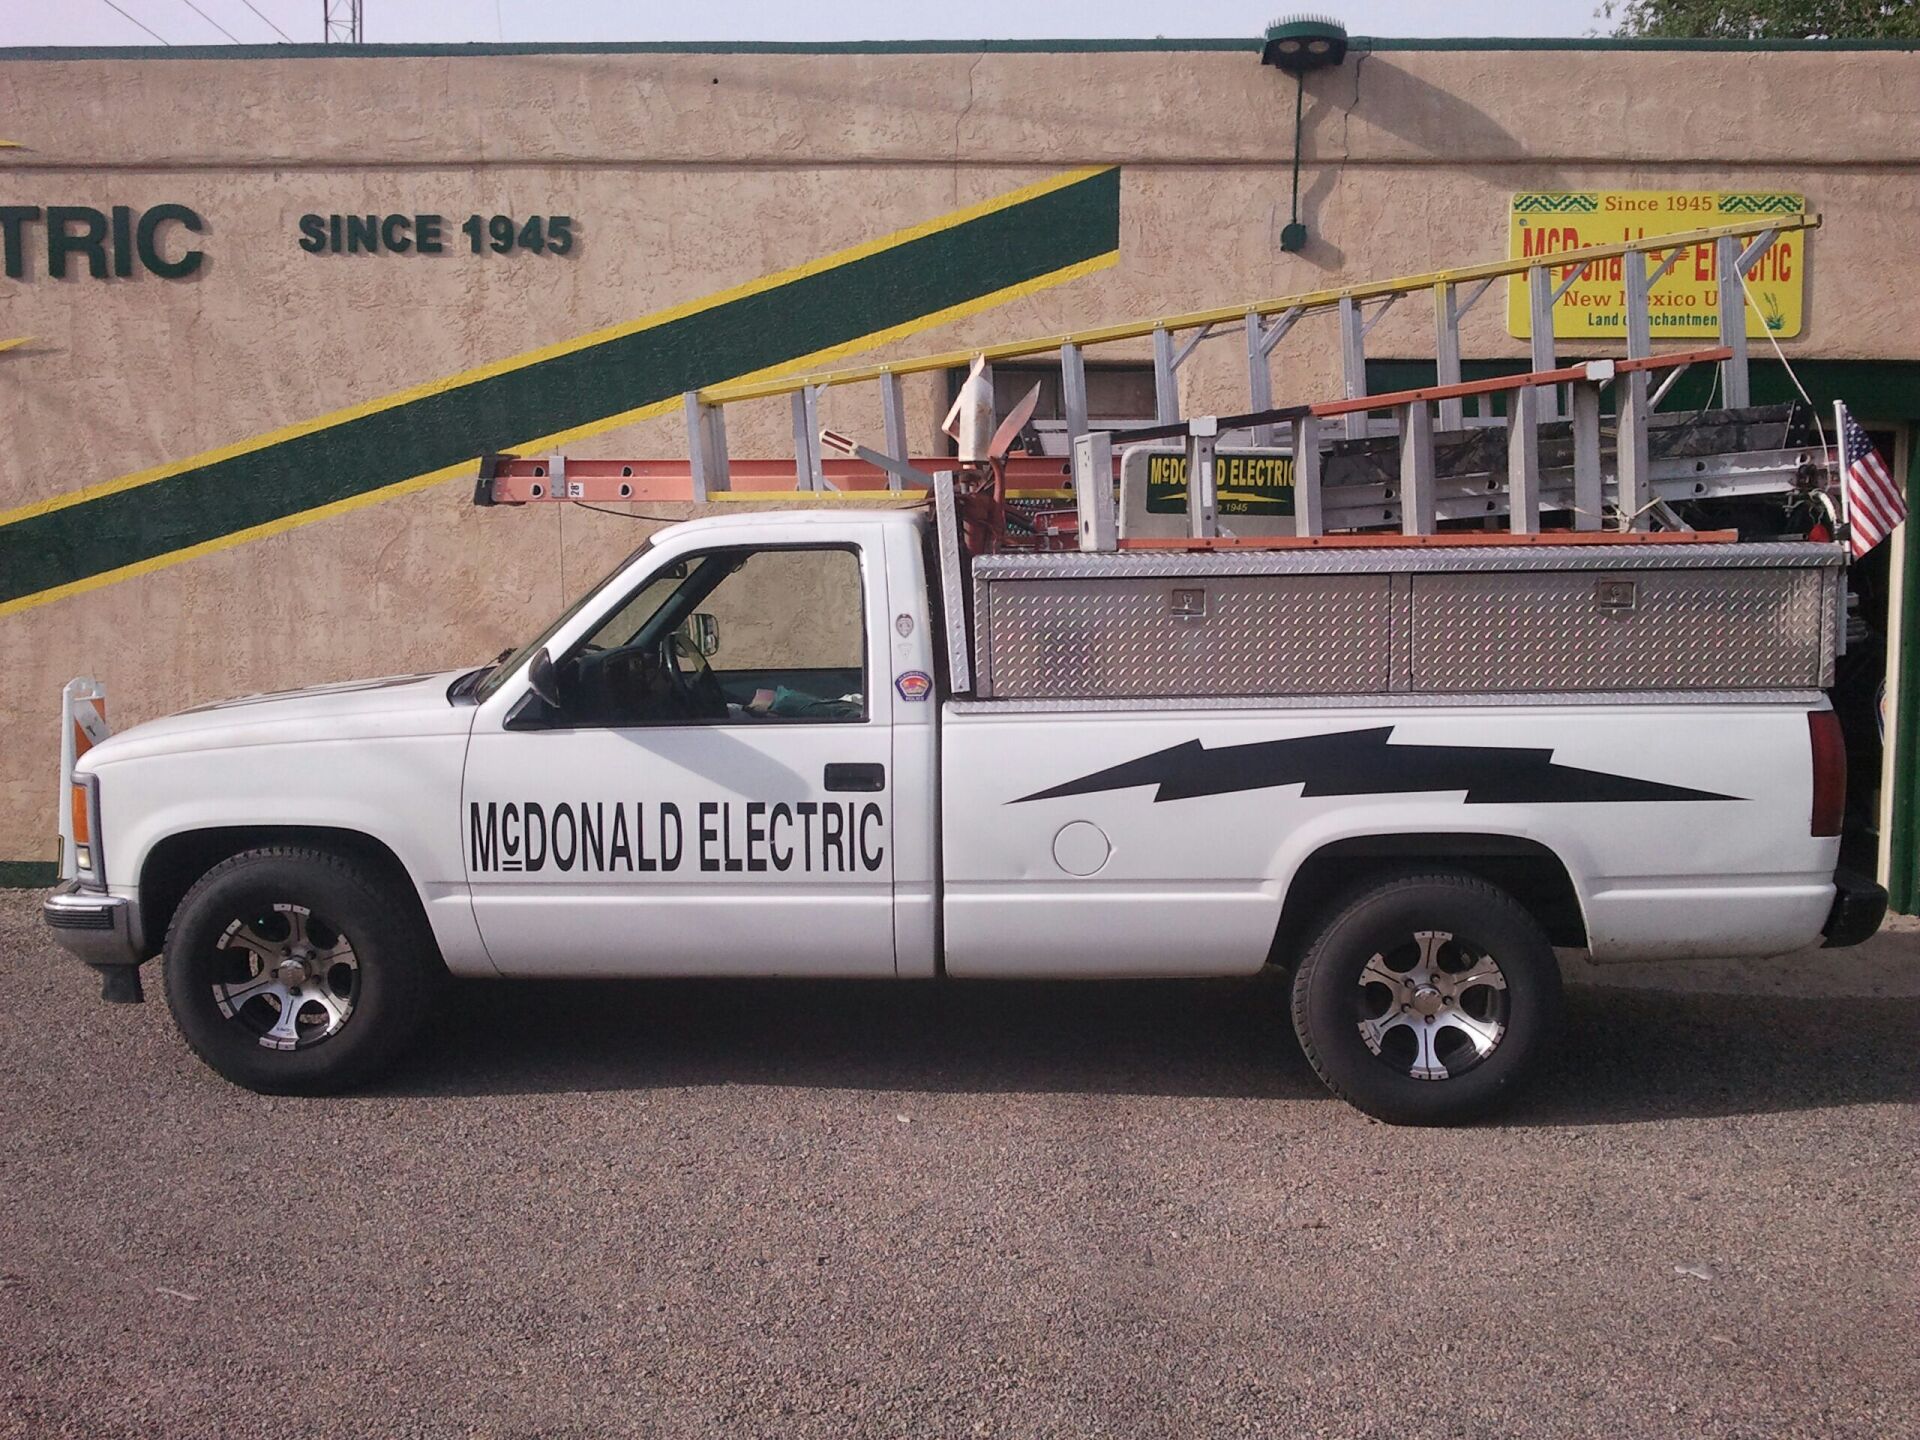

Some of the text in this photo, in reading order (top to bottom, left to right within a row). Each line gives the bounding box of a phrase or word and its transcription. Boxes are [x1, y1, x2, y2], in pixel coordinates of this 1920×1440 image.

[1605, 195, 1712, 211] Since 1945
[299, 213, 572, 254] SINCE 1945
[1523, 227, 1791, 281] McDona Elric
[1563, 290, 1611, 306] New
[1588, 313, 1618, 326] Land
[1648, 313, 1718, 326] nchantmen
[1151, 457, 1296, 486] McDOD ELECTRIC
[1226, 503, 1248, 513] 1945
[699, 802, 884, 872] ELECTRIC
